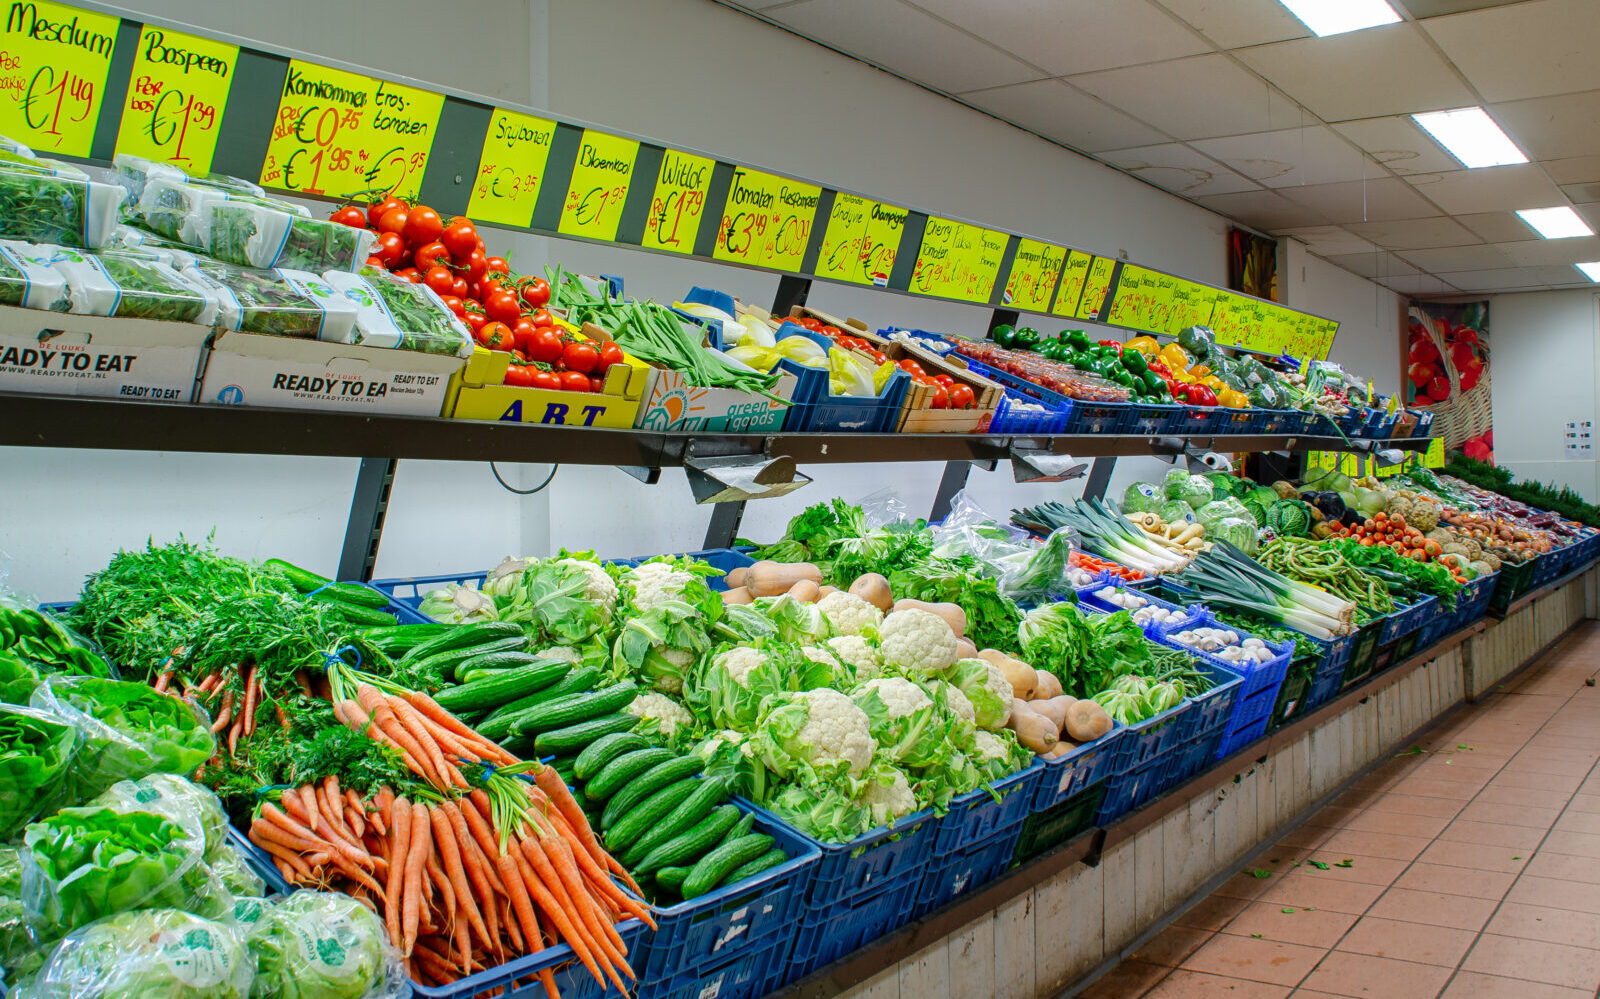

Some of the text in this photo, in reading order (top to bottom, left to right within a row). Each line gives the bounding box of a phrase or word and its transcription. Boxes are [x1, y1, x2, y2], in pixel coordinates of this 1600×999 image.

[6, 2, 114, 60] Mesclum
[144, 31, 228, 78] Bospeen
[130, 96, 155, 113] bos
[373, 110, 428, 136] tomaten
[268, 155, 276, 170] 3
[481, 164, 497, 176] per
[579, 144, 632, 175] Bloemkool
[263, 169, 281, 183] voor
[662, 153, 707, 190] Witlof
[731, 171, 775, 210] Tomaten
[926, 220, 953, 243] Cherry
[60, 352, 92, 371] TO
[94, 354, 138, 373] EAT
[272, 373, 388, 397] READY TO EA
[393, 375, 439, 386] READY TO EAT
[120, 385, 181, 399] READY TO EAT
[726, 400, 770, 419] green
[732, 412, 775, 432] goods
